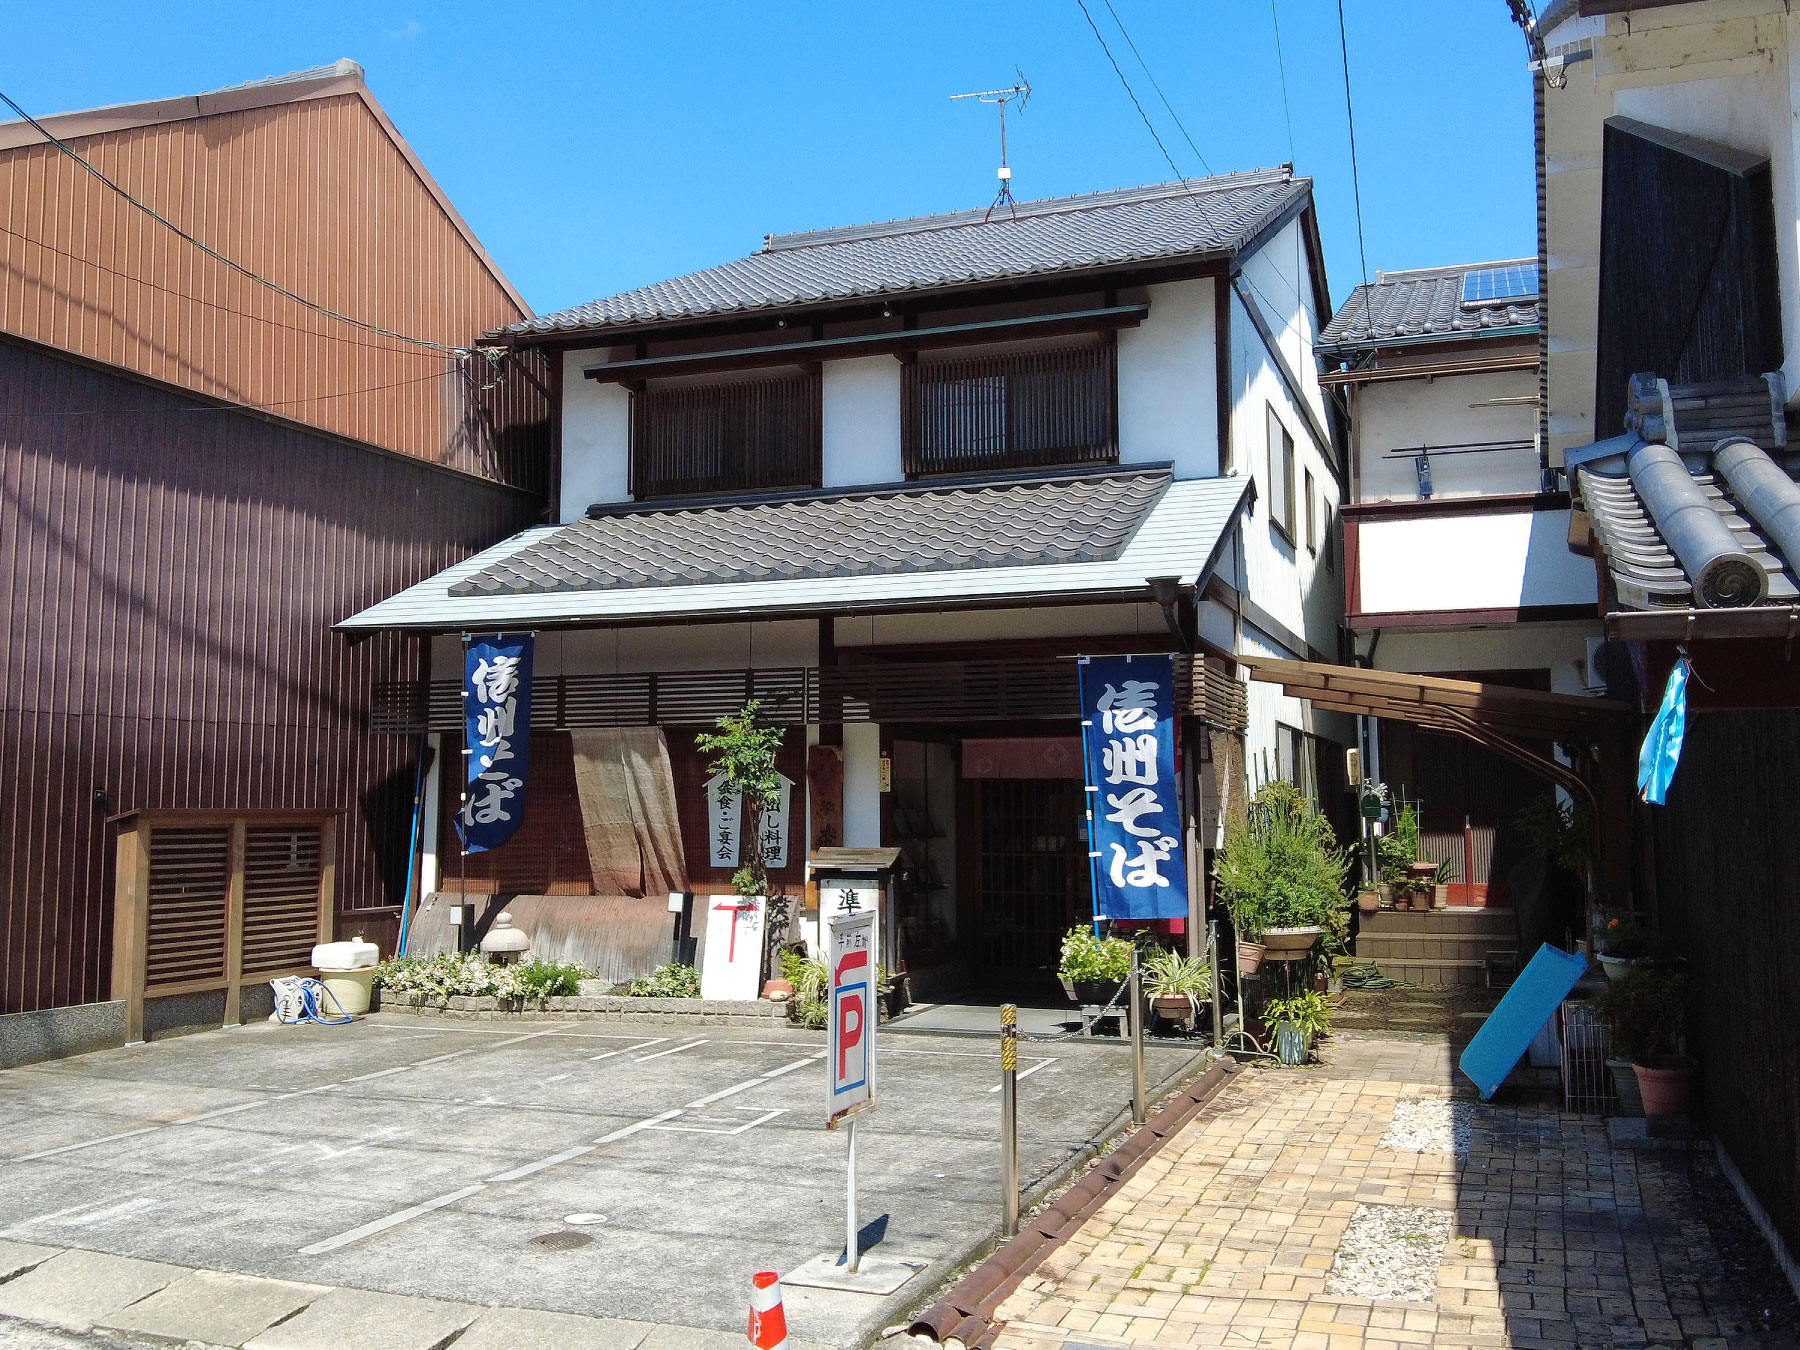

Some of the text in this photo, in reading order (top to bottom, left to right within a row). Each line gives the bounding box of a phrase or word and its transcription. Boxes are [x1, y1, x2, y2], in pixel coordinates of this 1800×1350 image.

[1464, 298, 1502, 307] Panasonic
[763, 783, 782, 861] 出し料理
[1096, 679, 1179, 888] 信州そば
[839, 994, 863, 1081] P
